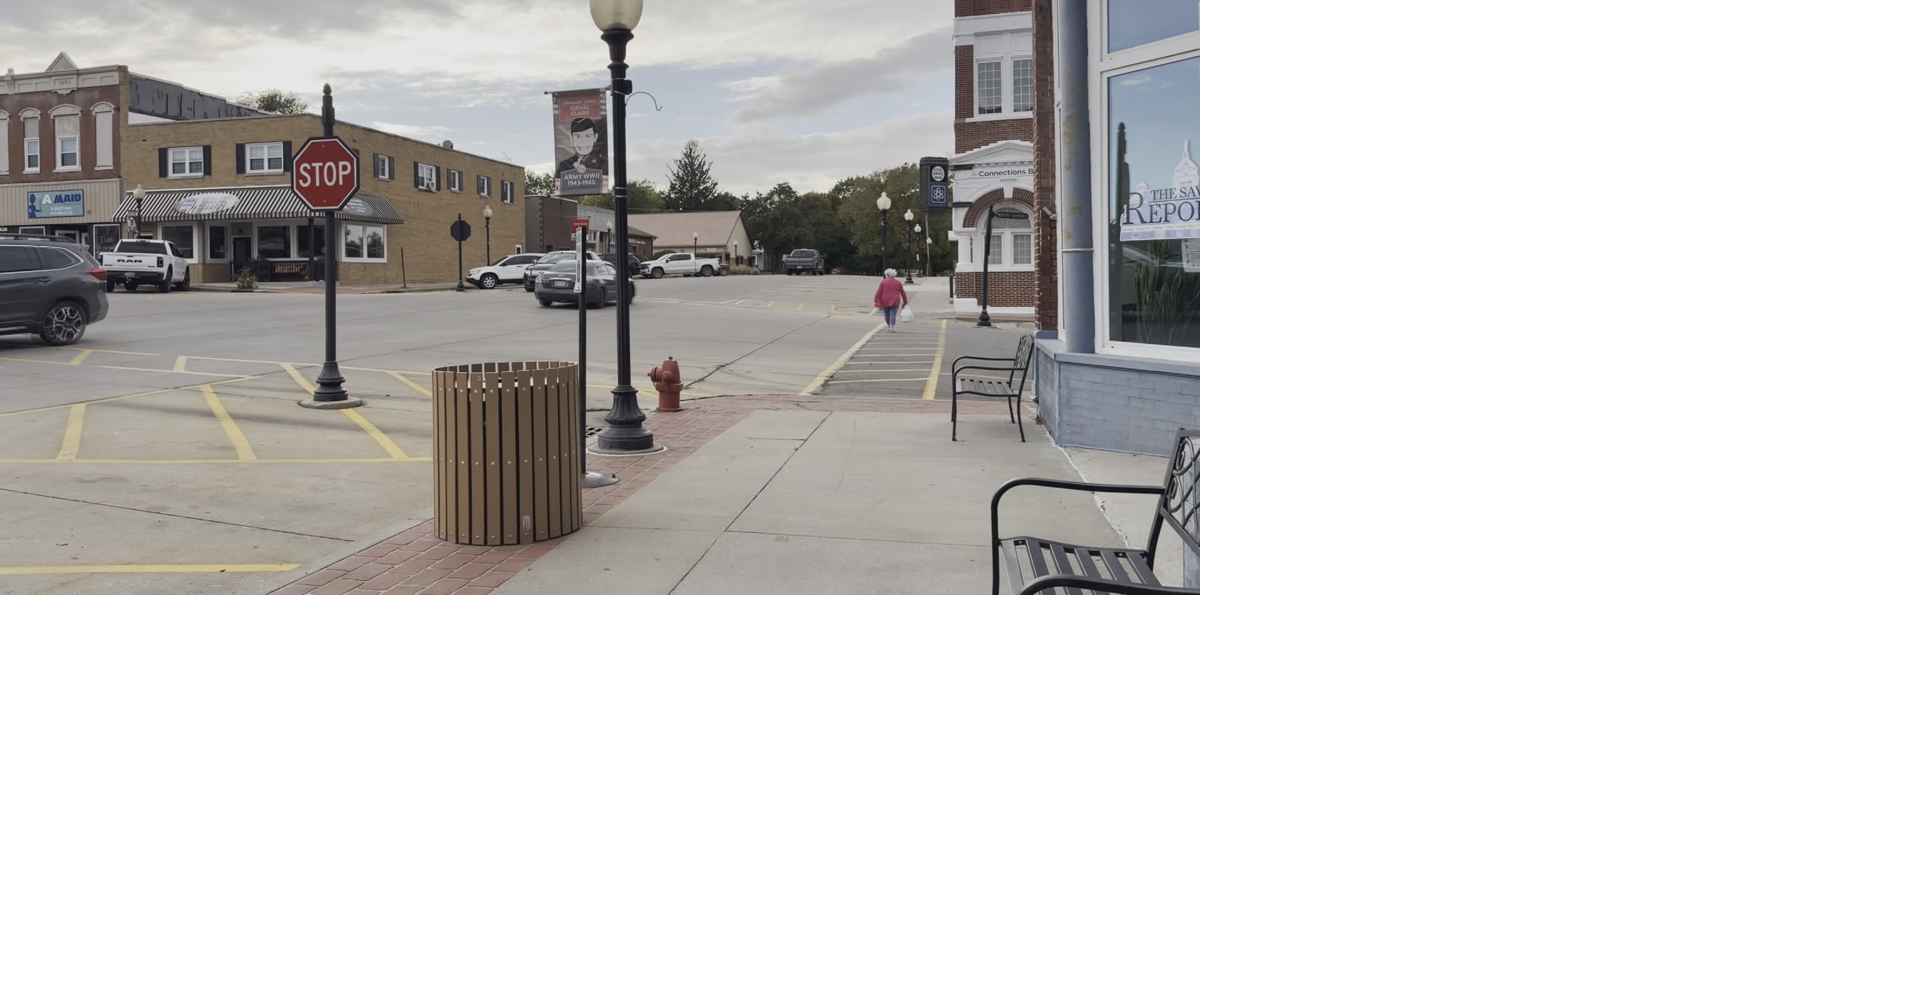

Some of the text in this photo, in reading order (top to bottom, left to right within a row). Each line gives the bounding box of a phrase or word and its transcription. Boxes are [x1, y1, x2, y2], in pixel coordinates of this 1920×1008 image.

[298, 161, 352, 188] STOP
[41, 193, 82, 205] A-MAID
[1150, 188, 1177, 201] THE
